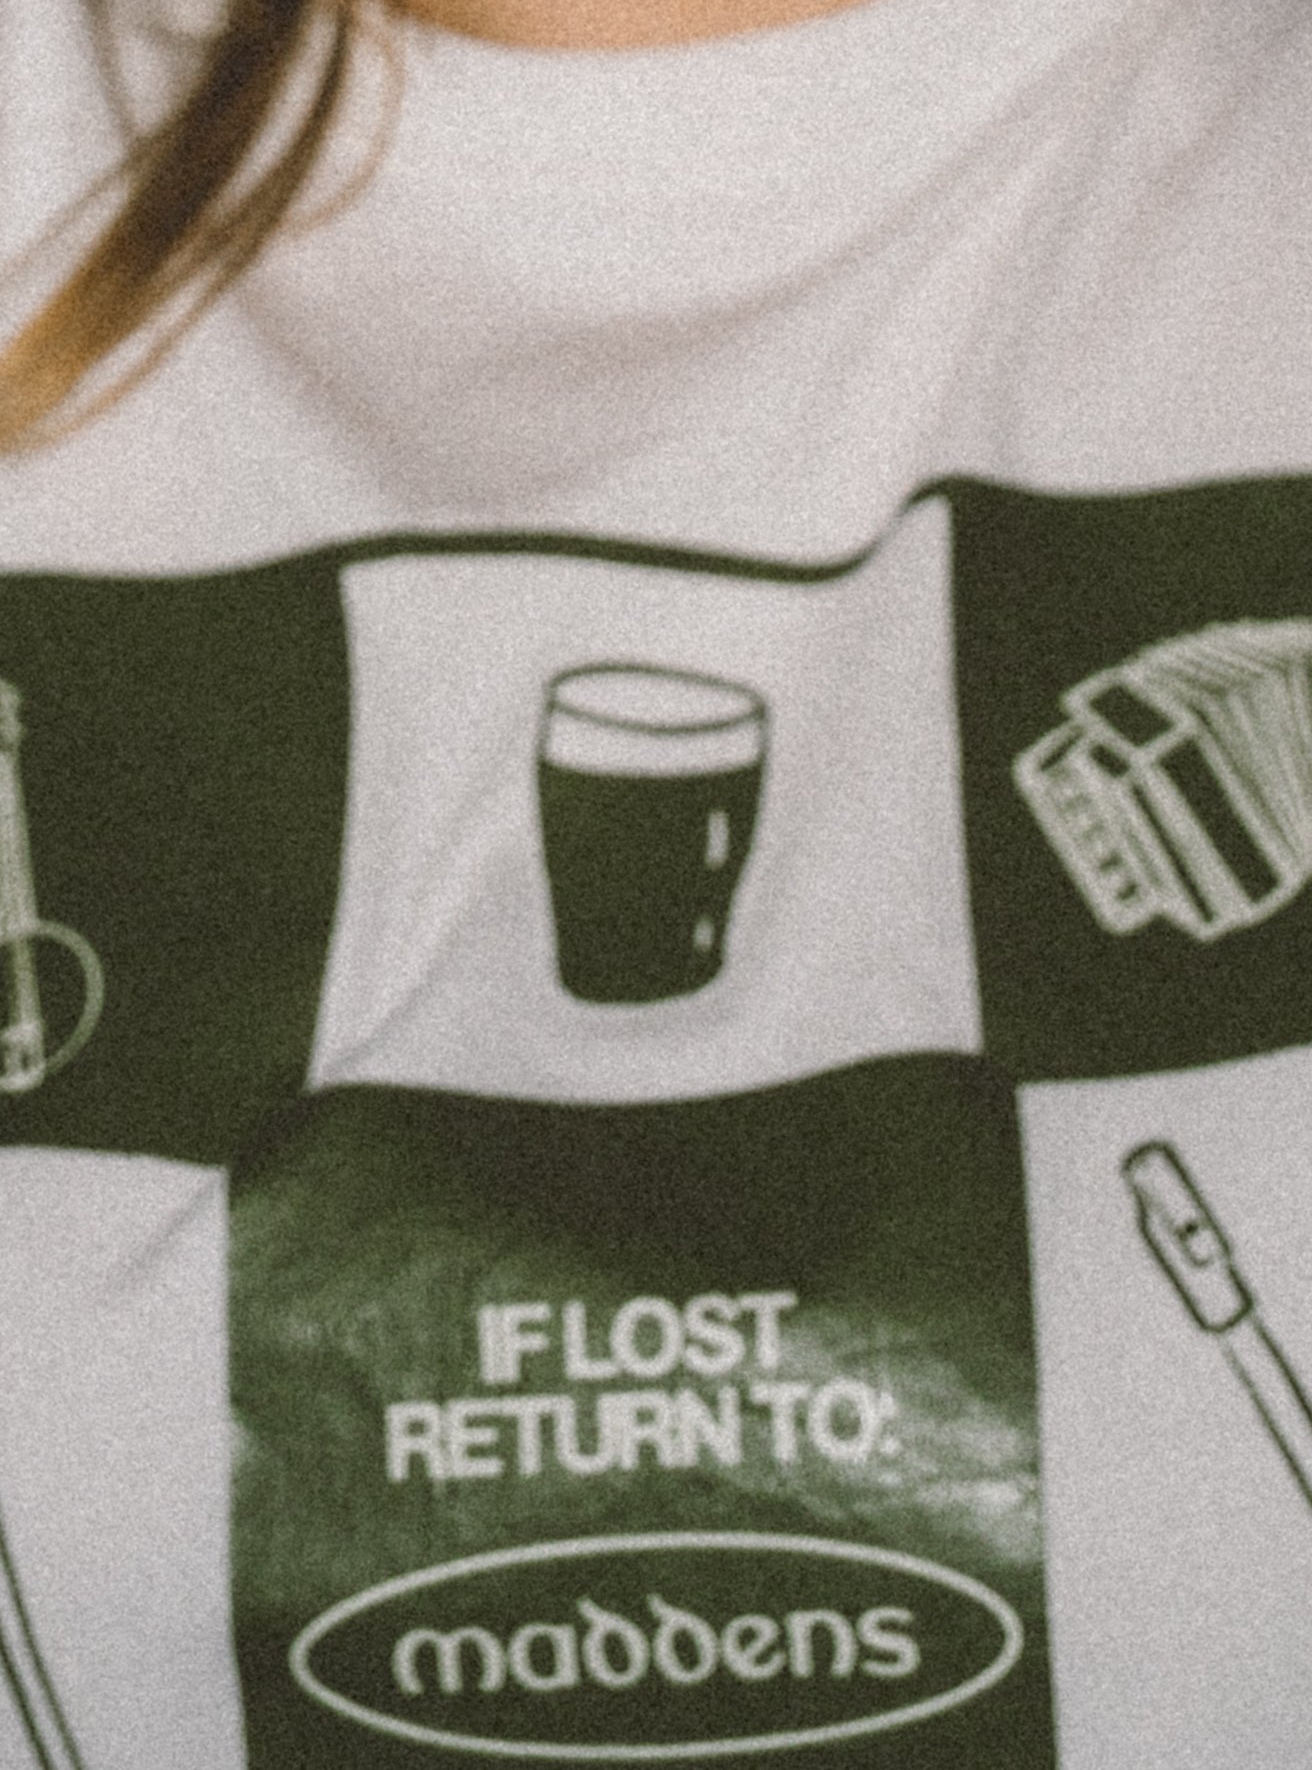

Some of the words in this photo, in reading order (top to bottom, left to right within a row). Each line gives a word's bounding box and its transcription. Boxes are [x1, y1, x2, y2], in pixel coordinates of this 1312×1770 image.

[477, 1302, 552, 1385] IF
[562, 1291, 799, 1382] LOST
[385, 1385, 743, 1483] RETURN
[391, 1592, 922, 1696] maddens
